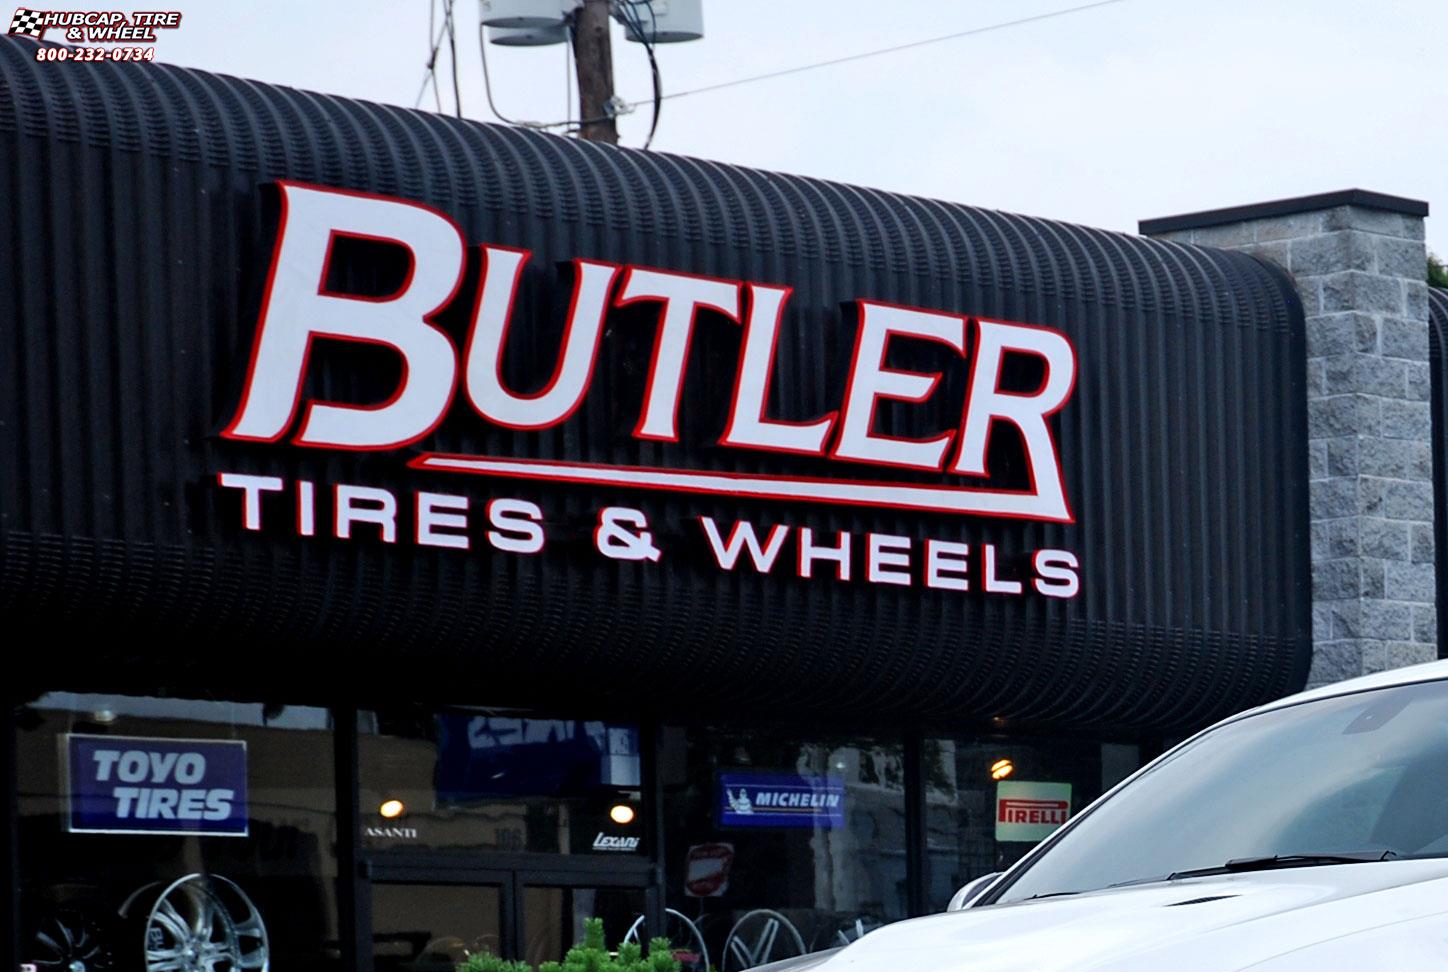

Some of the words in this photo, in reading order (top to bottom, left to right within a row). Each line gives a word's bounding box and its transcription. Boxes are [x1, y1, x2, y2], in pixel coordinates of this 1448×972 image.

[218, 179, 1078, 524] BUTLER
[218, 472, 546, 555] TIRES
[594, 506, 662, 562] &
[699, 515, 1081, 599] WHEELS
[93, 750, 206, 785] TOYO
[113, 787, 234, 821] TIRES
[755, 792, 840, 807] MICHELIN
[998, 799, 1068, 824] PIRELLI
[365, 827, 417, 838] ASANTI
